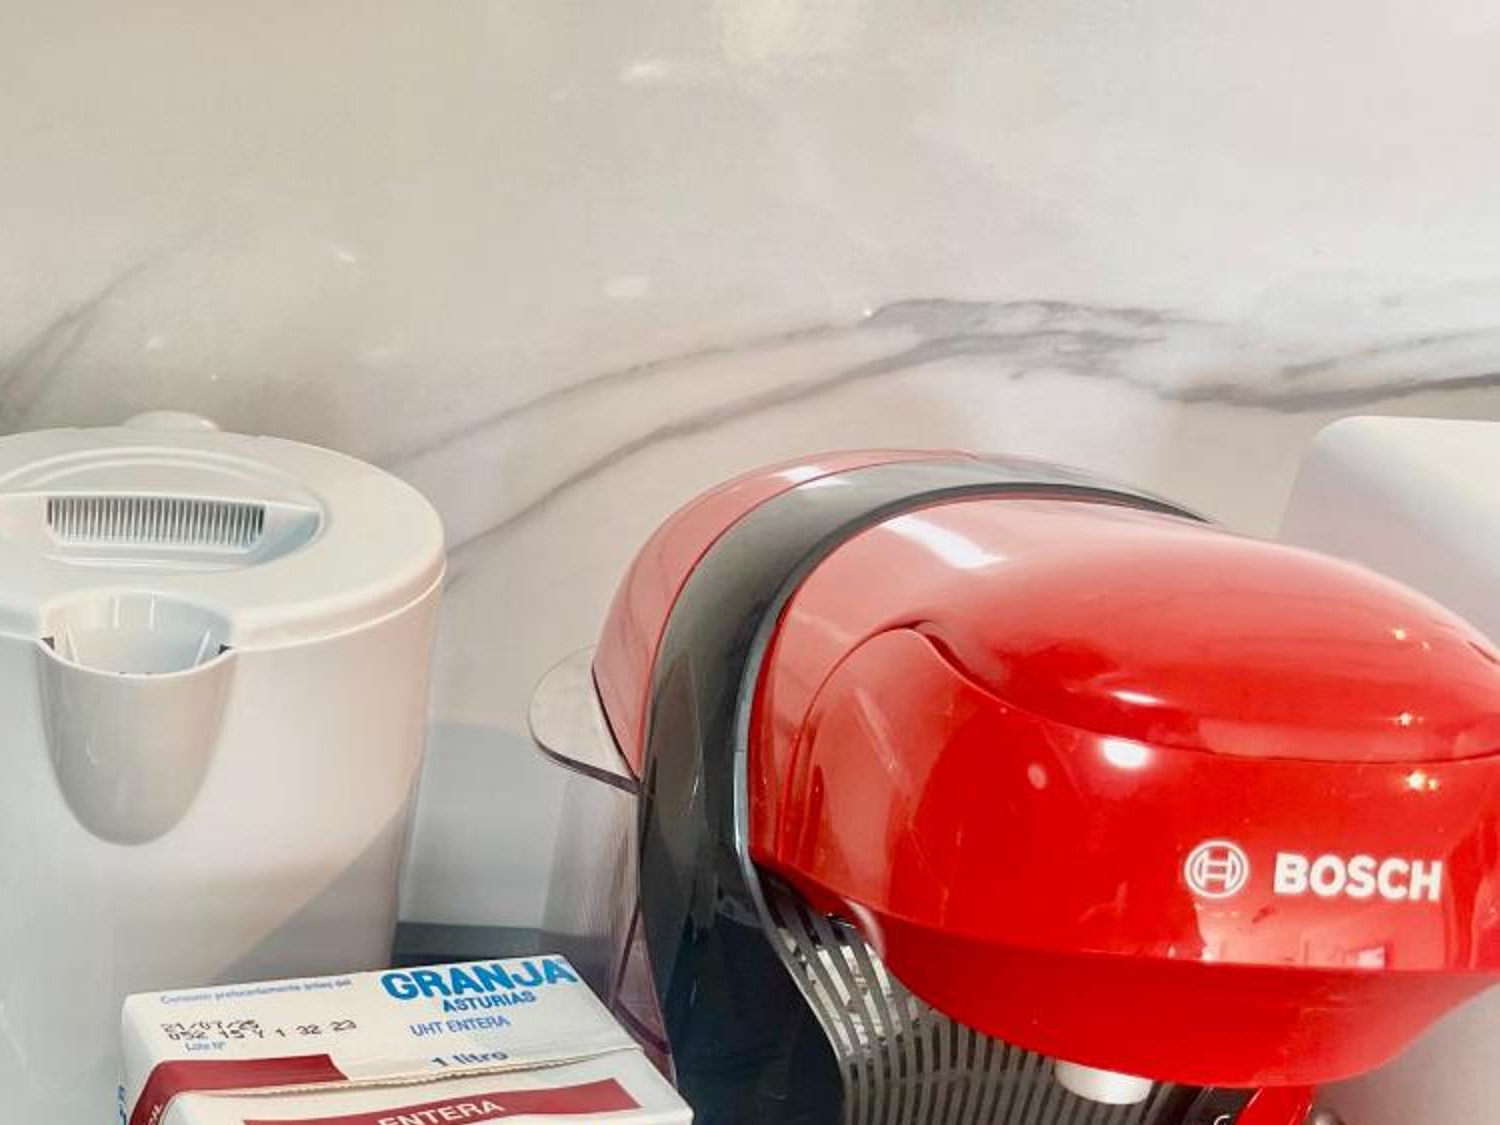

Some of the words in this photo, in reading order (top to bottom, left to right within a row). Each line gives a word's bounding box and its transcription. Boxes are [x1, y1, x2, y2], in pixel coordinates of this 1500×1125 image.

[1273, 851, 1444, 902] BOSCH
[380, 957, 578, 1001] GRANJA
[442, 989, 537, 1013] ASTURIAS
[409, 1020, 443, 1037] UHT
[445, 1014, 512, 1034] ENTERA
[431, 1056, 449, 1069] 1
[452, 1050, 509, 1066] litro
